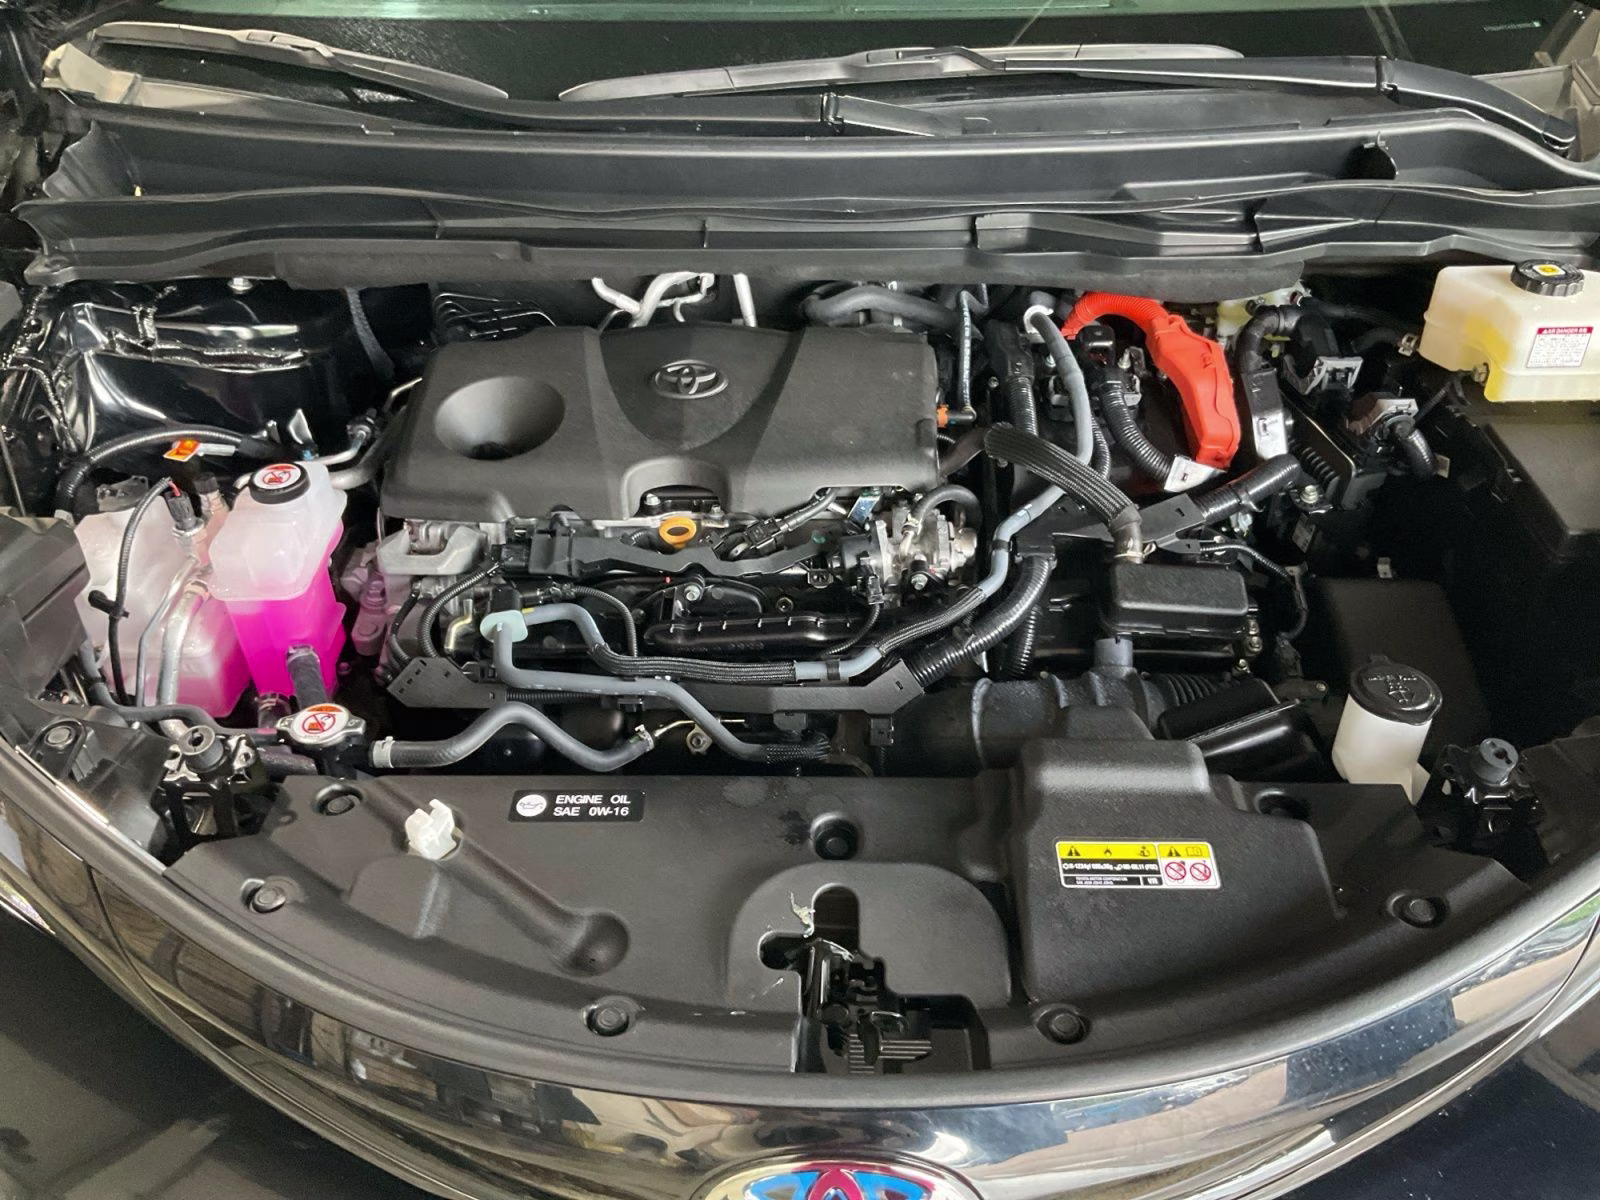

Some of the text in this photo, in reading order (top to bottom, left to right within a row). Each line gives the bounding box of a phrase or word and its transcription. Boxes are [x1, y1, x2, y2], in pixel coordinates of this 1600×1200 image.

[555, 795, 631, 804] ENGINE OIL
[553, 806, 629, 816] SAE 0W-16
